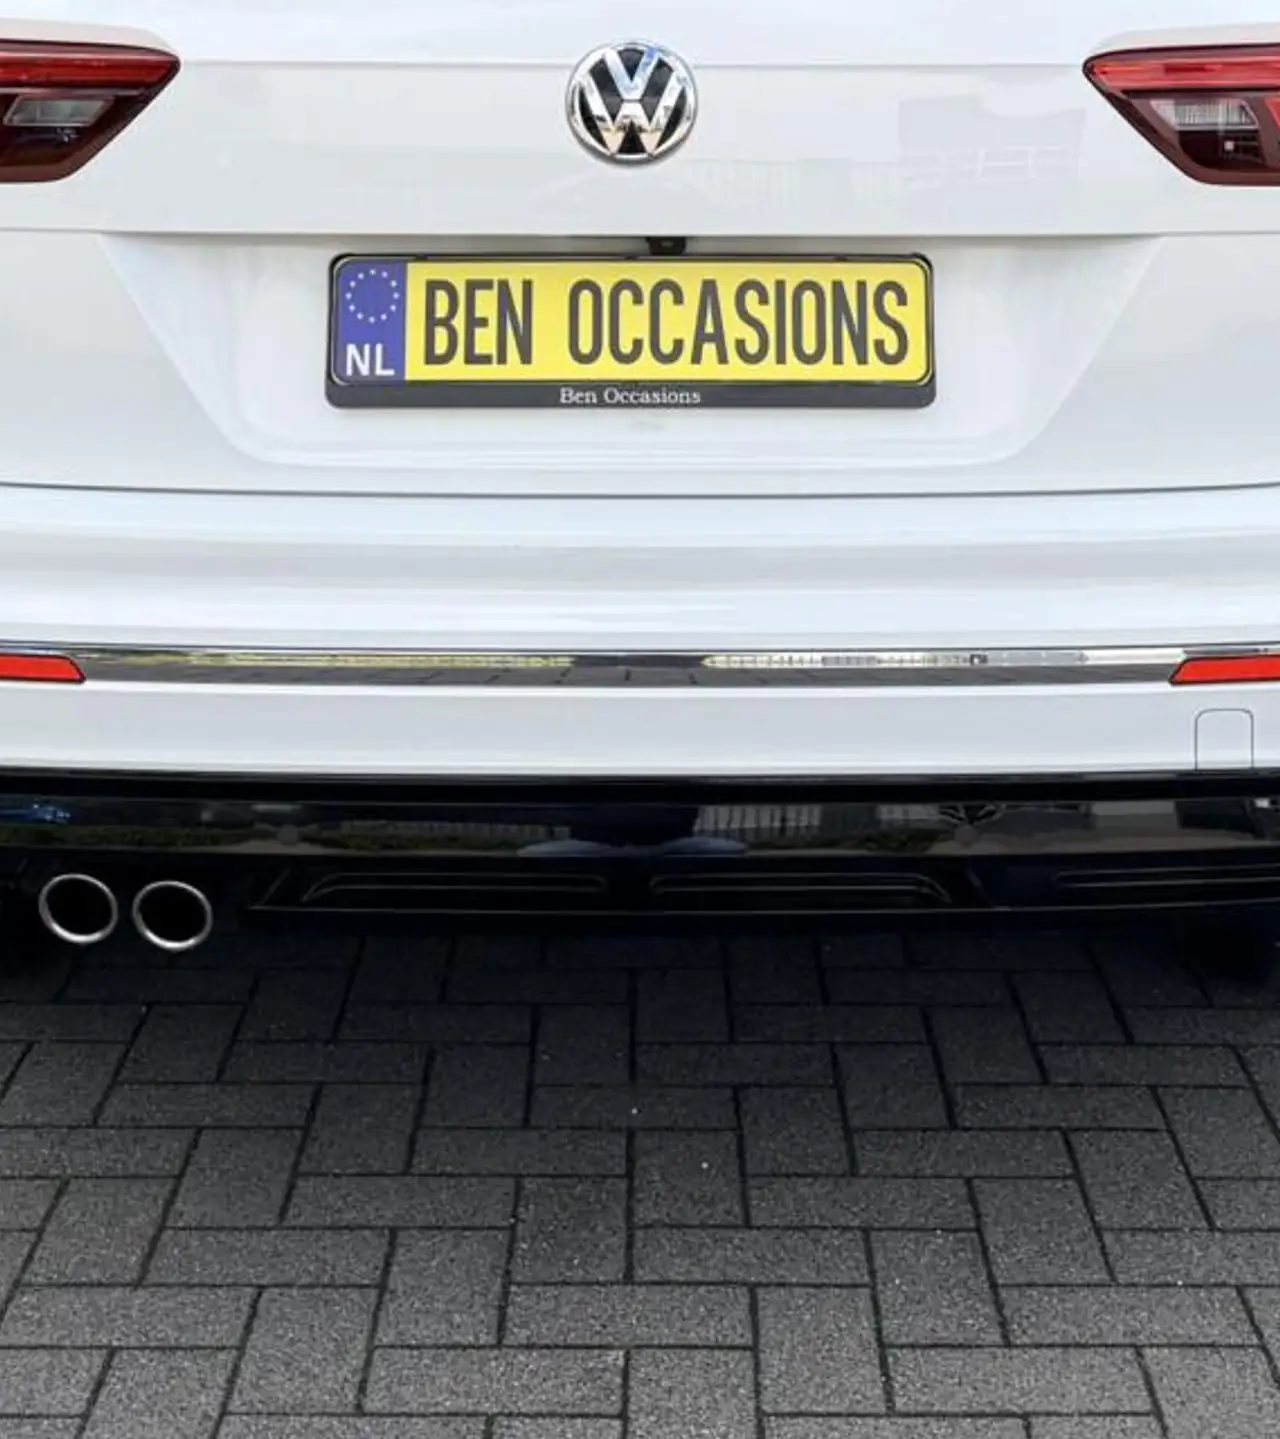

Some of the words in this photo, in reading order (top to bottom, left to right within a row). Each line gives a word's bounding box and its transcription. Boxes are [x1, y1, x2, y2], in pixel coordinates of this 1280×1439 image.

[423, 279, 533, 365] BEN
[568, 278, 909, 365] OCCASIONS
[345, 344, 395, 378] NL
[559, 387, 598, 405] Ben
[604, 387, 701, 405] Occasions
